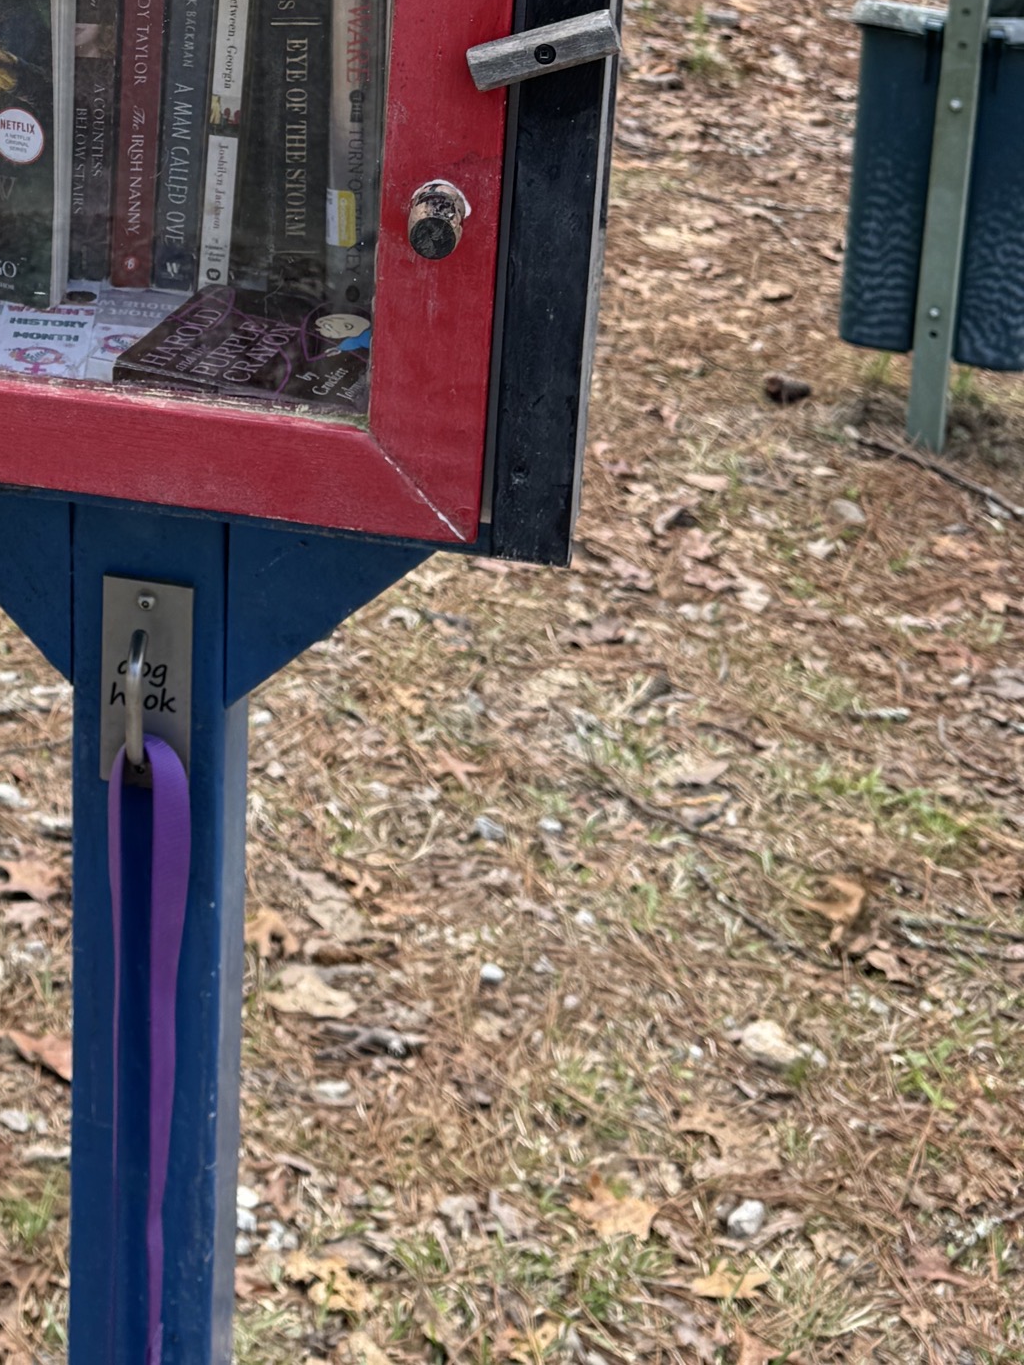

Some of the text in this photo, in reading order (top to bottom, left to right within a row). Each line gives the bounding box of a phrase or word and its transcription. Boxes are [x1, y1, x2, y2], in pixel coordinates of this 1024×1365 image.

[132, 23, 151, 85] TAYLOR
[181, 9, 198, 68] BACKMAN
[222, 44, 238, 90] Georgia
[345, 4, 373, 84] WARE
[0, 118, 36, 135] NETFLIX
[90, 96, 106, 178] COUNTESS
[285, 37, 309, 237] EYE OF THE STORM
[347, 129, 364, 176] TURN
[72, 107, 88, 215] BELOW STAIRS
[127, 104, 146, 235] The IRISH NANNY
[163, 82, 195, 246] A MAN CALLED OVE
[213, 142, 230, 187] Joshilyn
[345, 243, 363, 276] KEY
[9, 317, 87, 328] HISTORY
[13, 331, 79, 342] MONTH
[139, 308, 223, 367] HAROLD
[189, 320, 269, 378] PURPLE
[222, 323, 302, 383] CRAYON
[295, 370, 320, 383] by
[109, 682, 177, 713] hok
